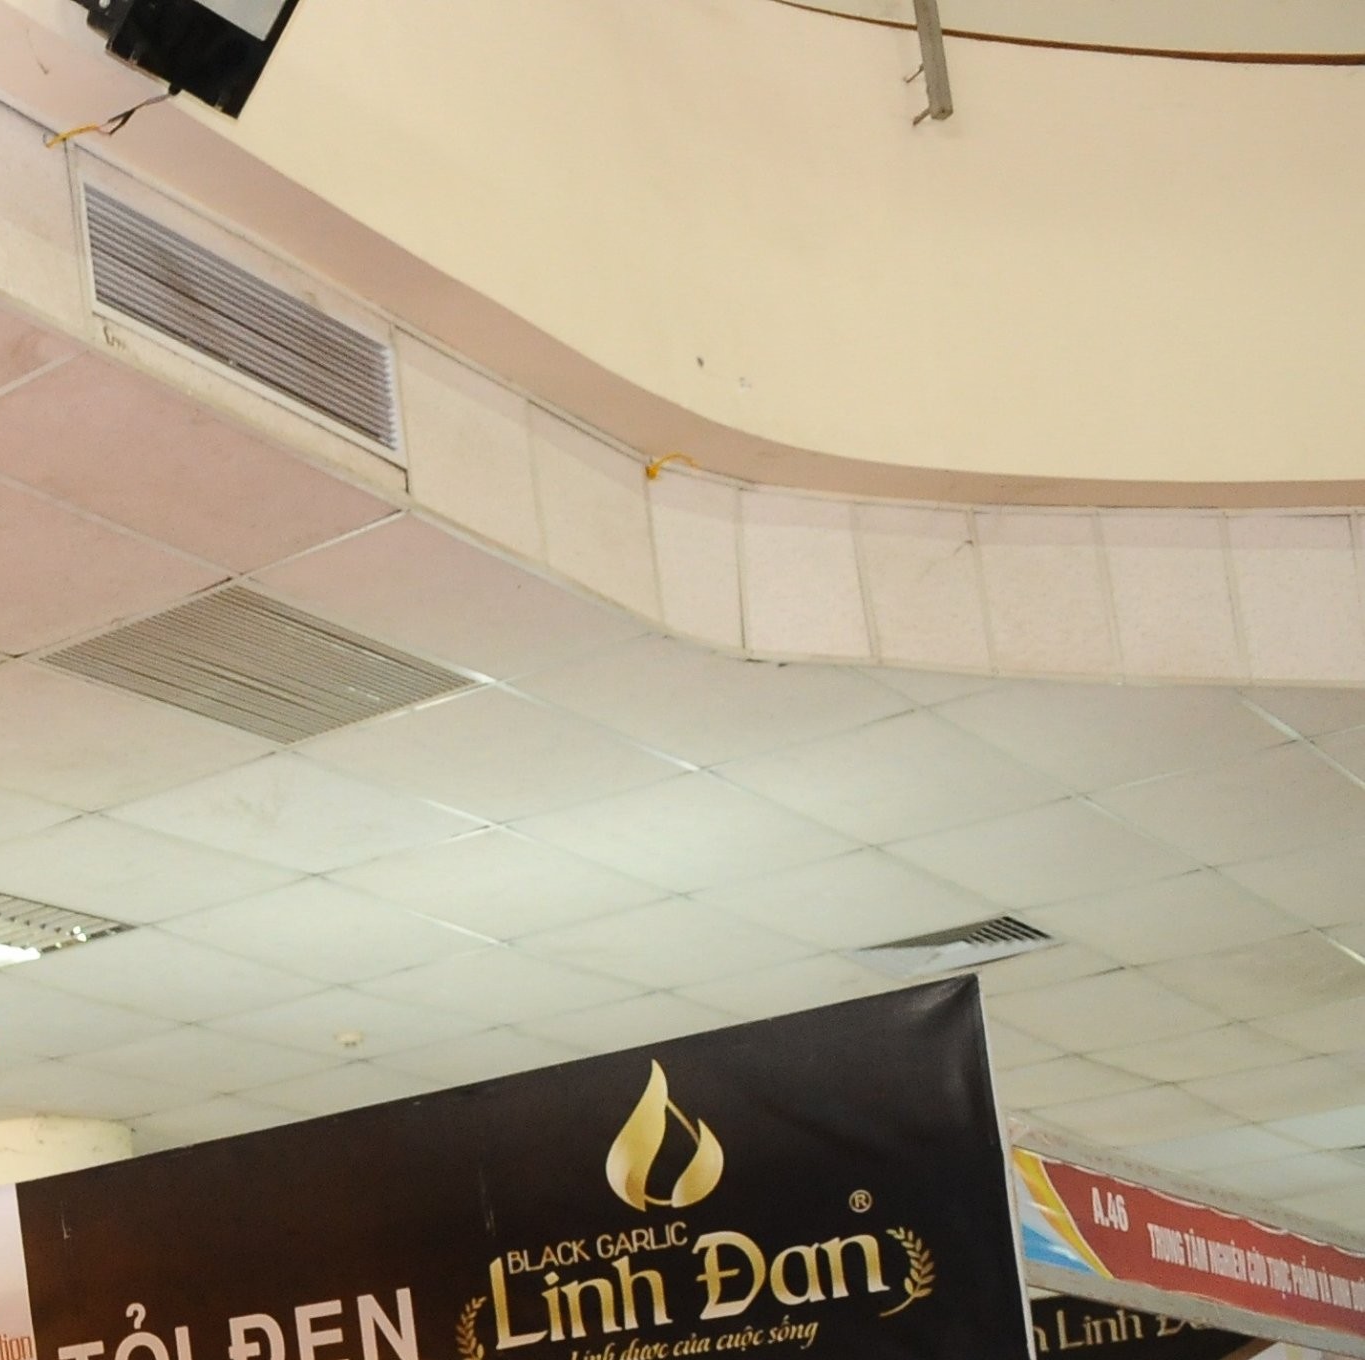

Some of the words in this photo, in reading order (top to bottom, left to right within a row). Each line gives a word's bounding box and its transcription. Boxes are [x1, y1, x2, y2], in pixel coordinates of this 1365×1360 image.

[1090, 1186, 1130, 1233] A.46
[508, 1239, 590, 1275] BLACK
[596, 1220, 688, 1260] GARLIC
[489, 1256, 674, 1351] Linh
[693, 1230, 891, 1320] Đan
[673, 1332, 711, 1357] của
[716, 1324, 765, 1354] cuộc
[768, 1316, 819, 1350] sống
[1056, 1306, 1144, 1352] Linh
